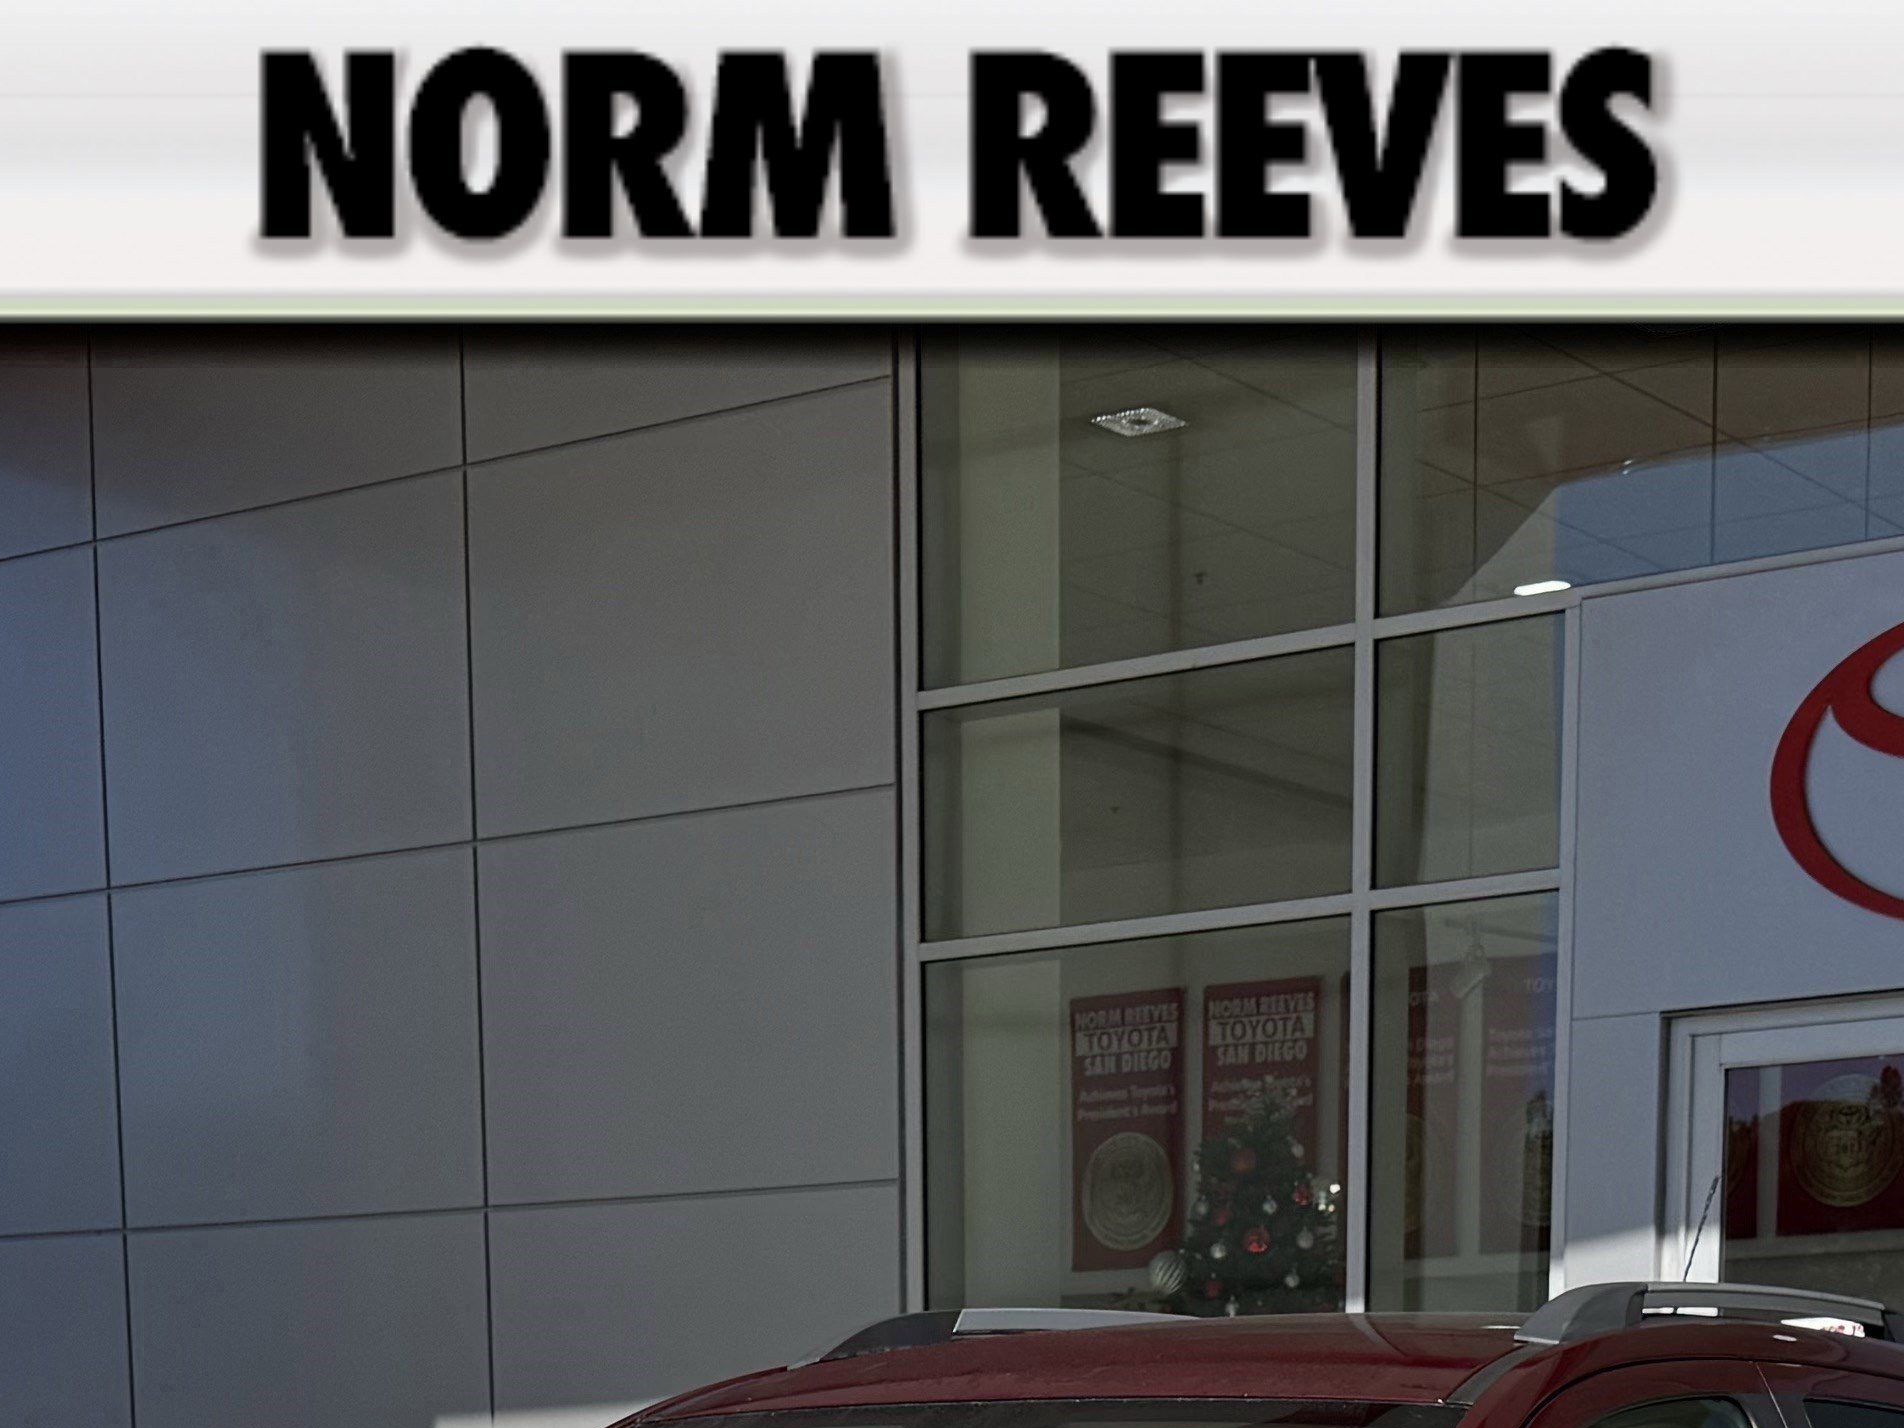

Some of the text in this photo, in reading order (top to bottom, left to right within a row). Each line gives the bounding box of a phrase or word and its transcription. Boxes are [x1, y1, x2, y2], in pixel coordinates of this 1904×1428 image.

[1075, 1002, 1179, 1031] NORM REEVES
[1208, 991, 1315, 1018] NORM REEVES
[1083, 1025, 1169, 1053] TOYOTA
[1217, 1016, 1305, 1041] TOYOTA
[1084, 1050, 1172, 1076] SAN DIEGO
[1217, 1040, 1308, 1066] SAN DIEGO
